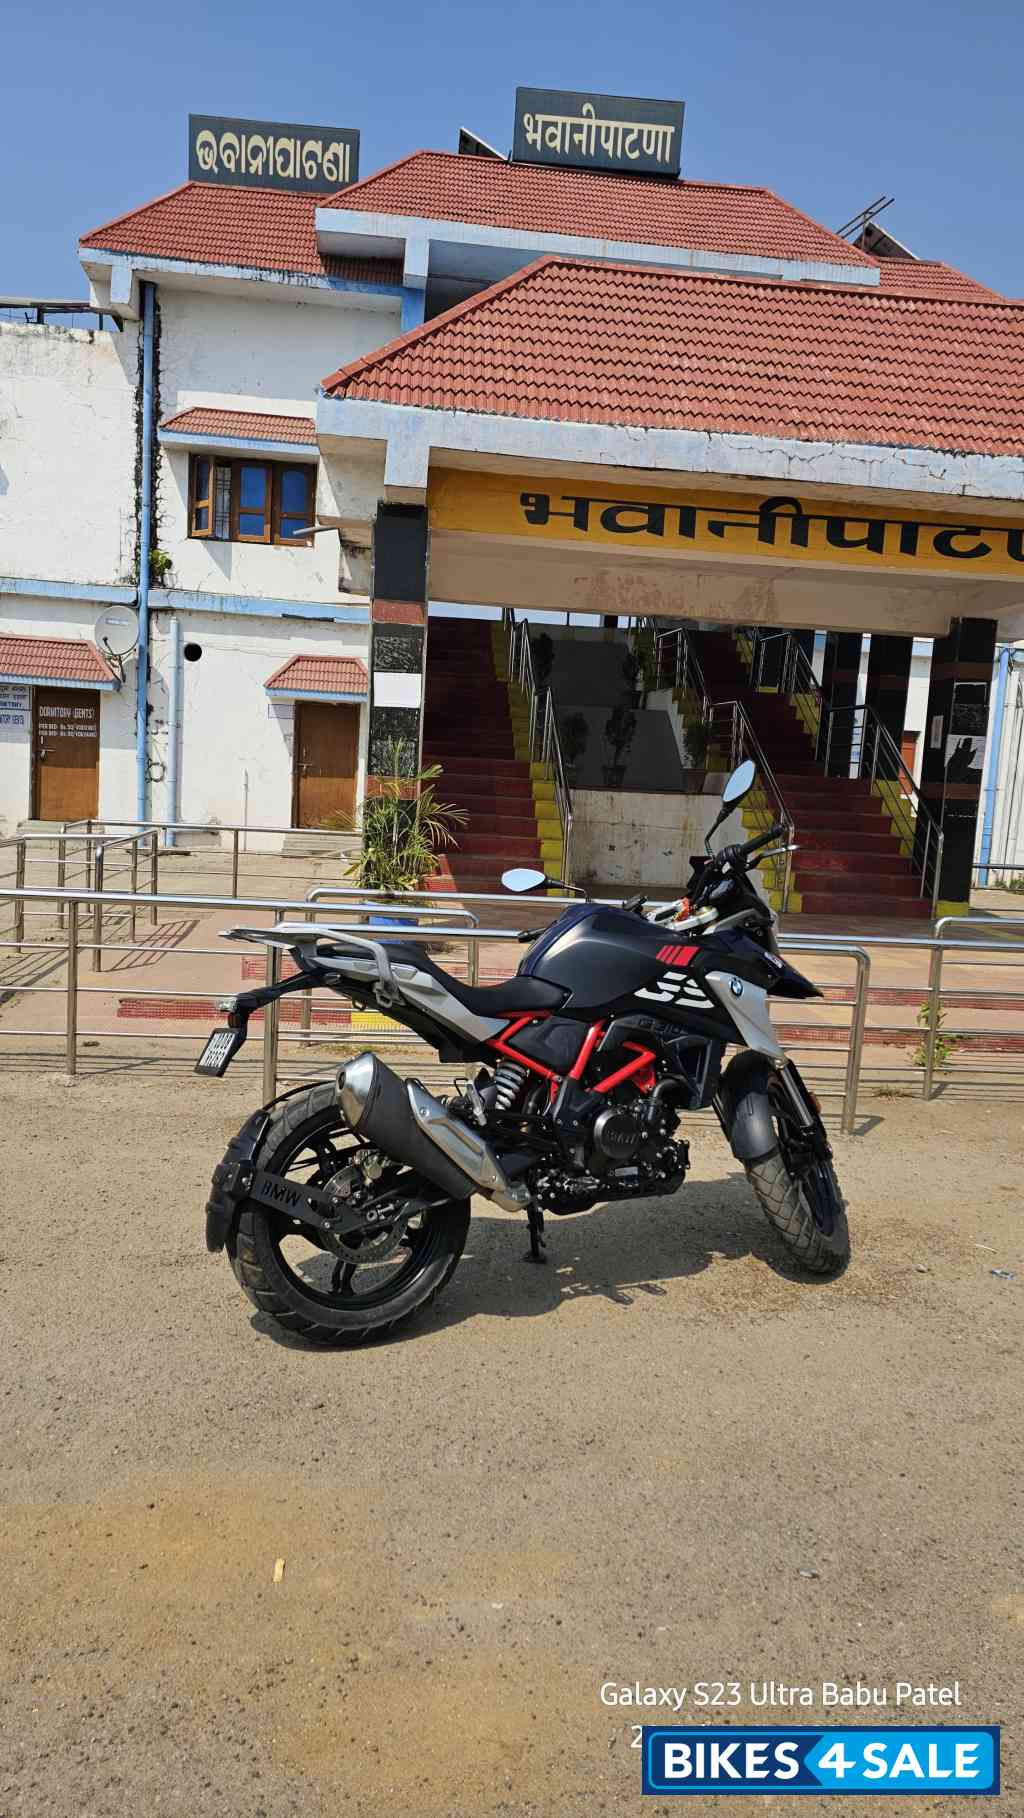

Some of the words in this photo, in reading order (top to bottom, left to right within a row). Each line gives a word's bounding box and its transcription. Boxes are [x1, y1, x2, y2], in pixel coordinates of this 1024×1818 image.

[523, 102, 676, 164] भवानीपाटणा
[196, 130, 350, 183] ଭବାନୀପାଟଣା
[39, 706, 72, 718] DORMITORY
[261, 1179, 303, 1207] BMW
